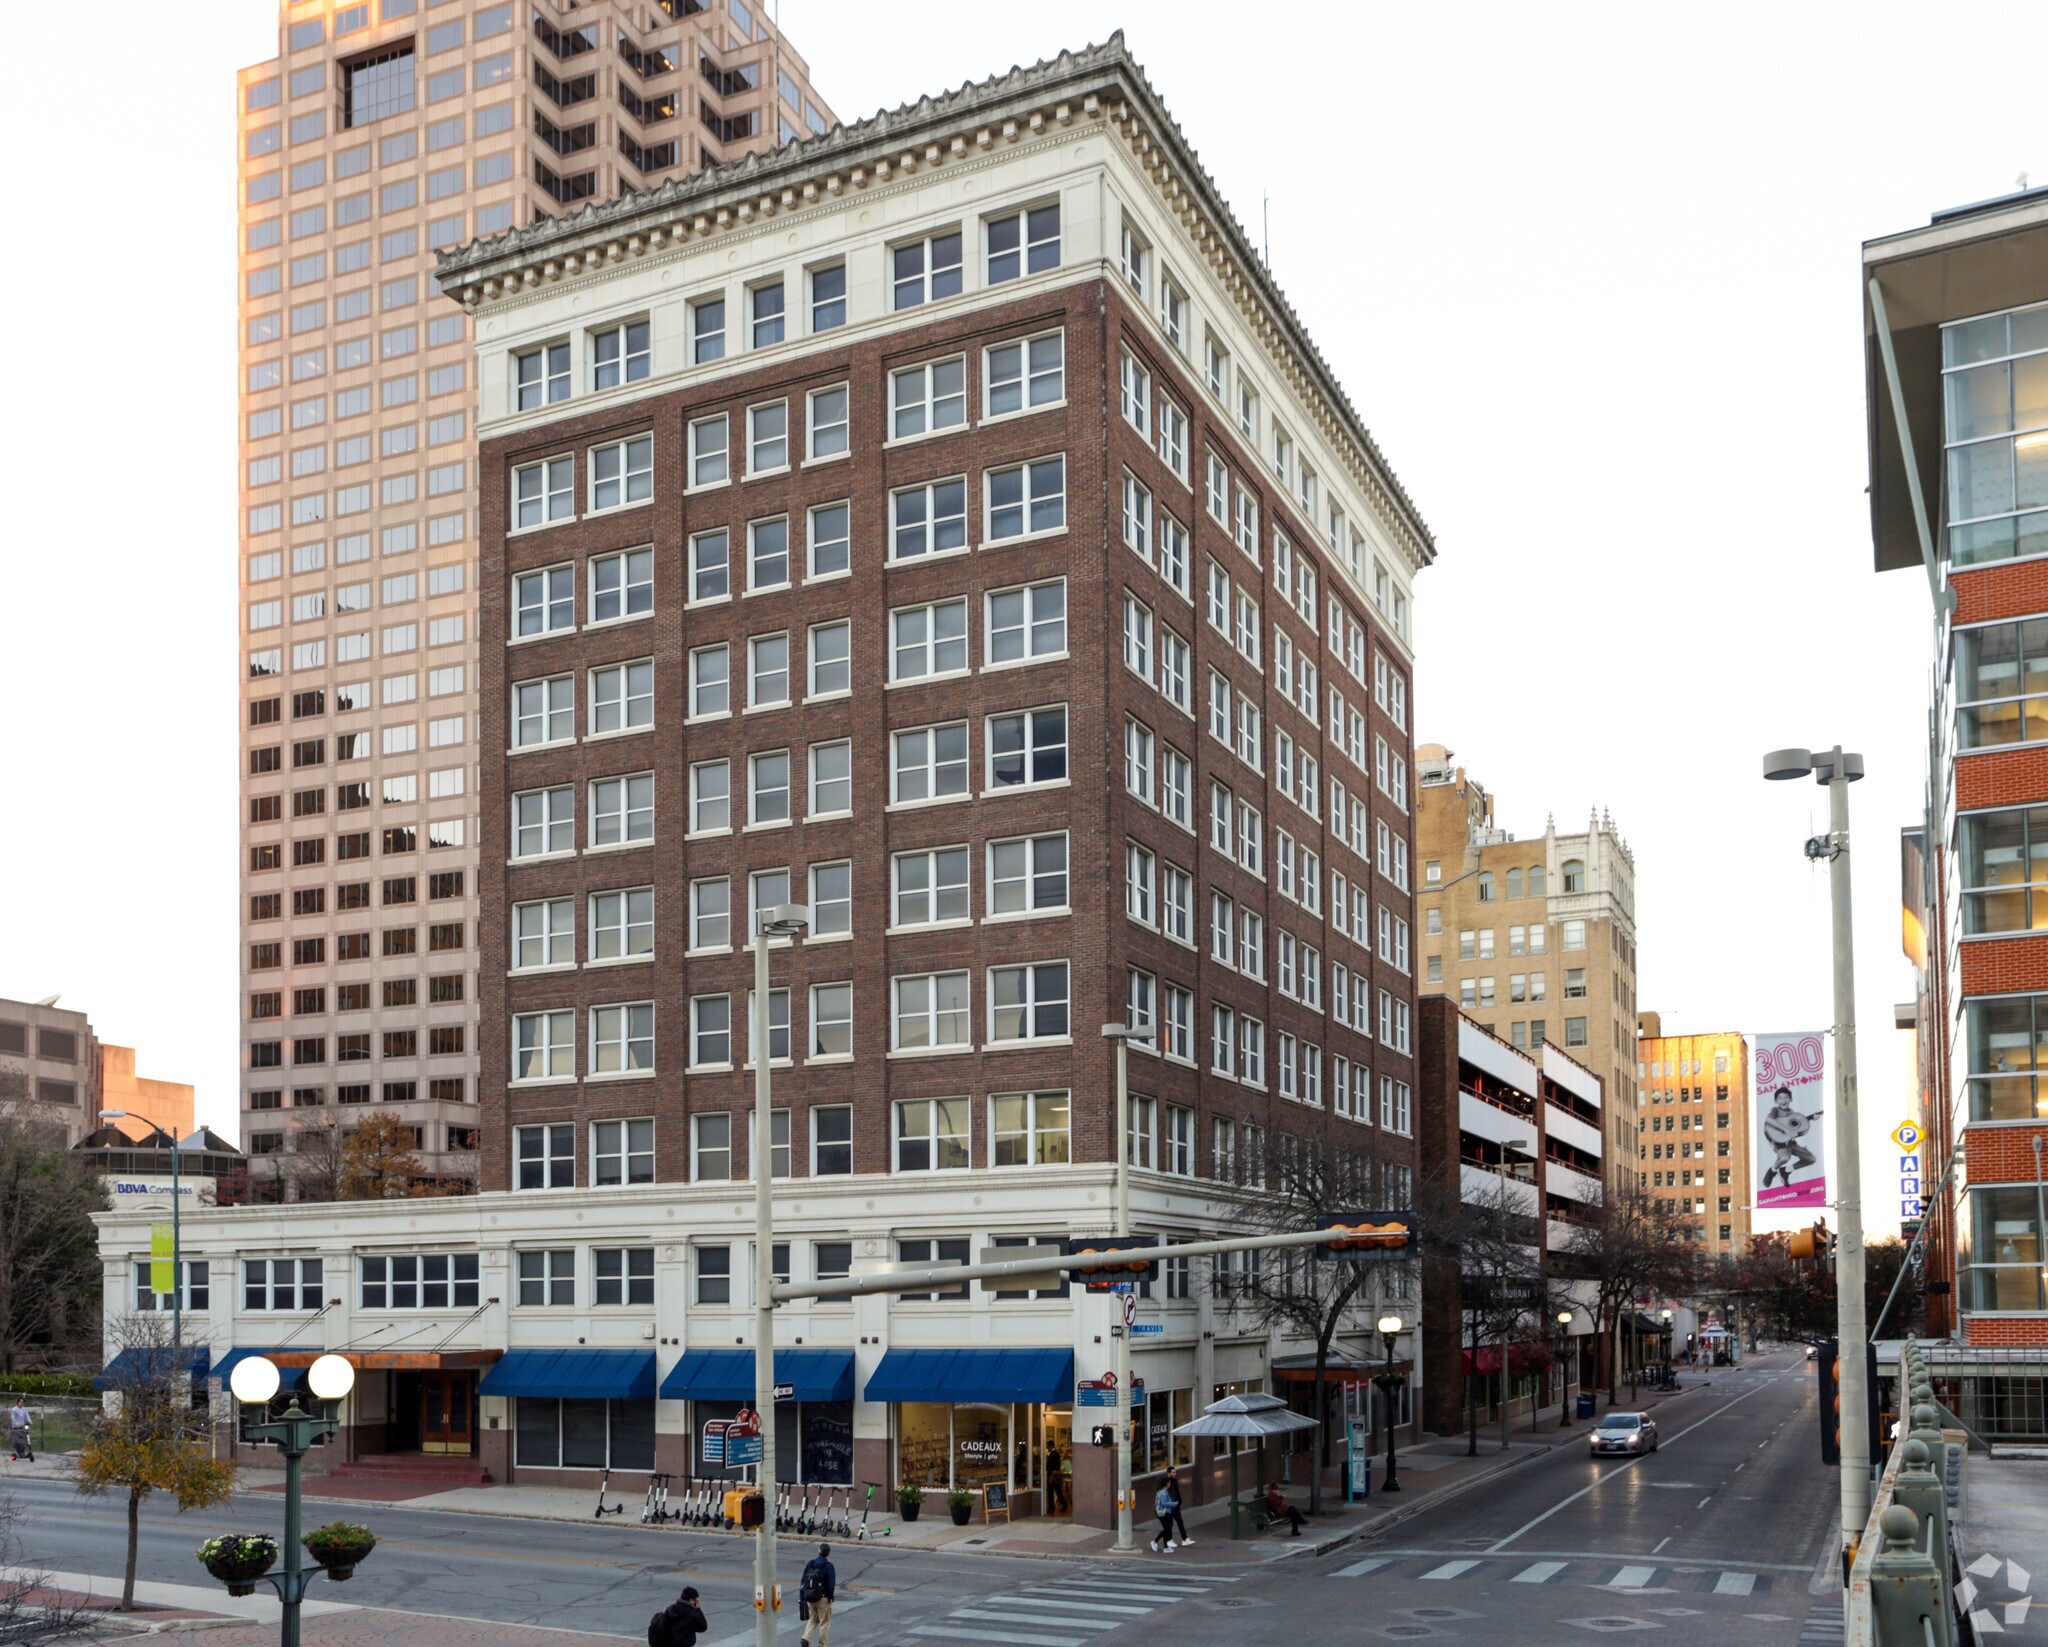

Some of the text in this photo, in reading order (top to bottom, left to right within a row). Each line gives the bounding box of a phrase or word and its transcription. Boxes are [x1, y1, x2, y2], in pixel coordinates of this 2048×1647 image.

[1756, 1036, 1824, 1085] 300
[1756, 1083, 1778, 1095] SAN
[1901, 1128, 1917, 1216] PARK
[117, 1184, 148, 1193] BBVA
[1490, 1289, 1531, 1299] RESAURANT
[1138, 1325, 1163, 1333] TRAVIS
[961, 1441, 1002, 1452] CADEAUX
